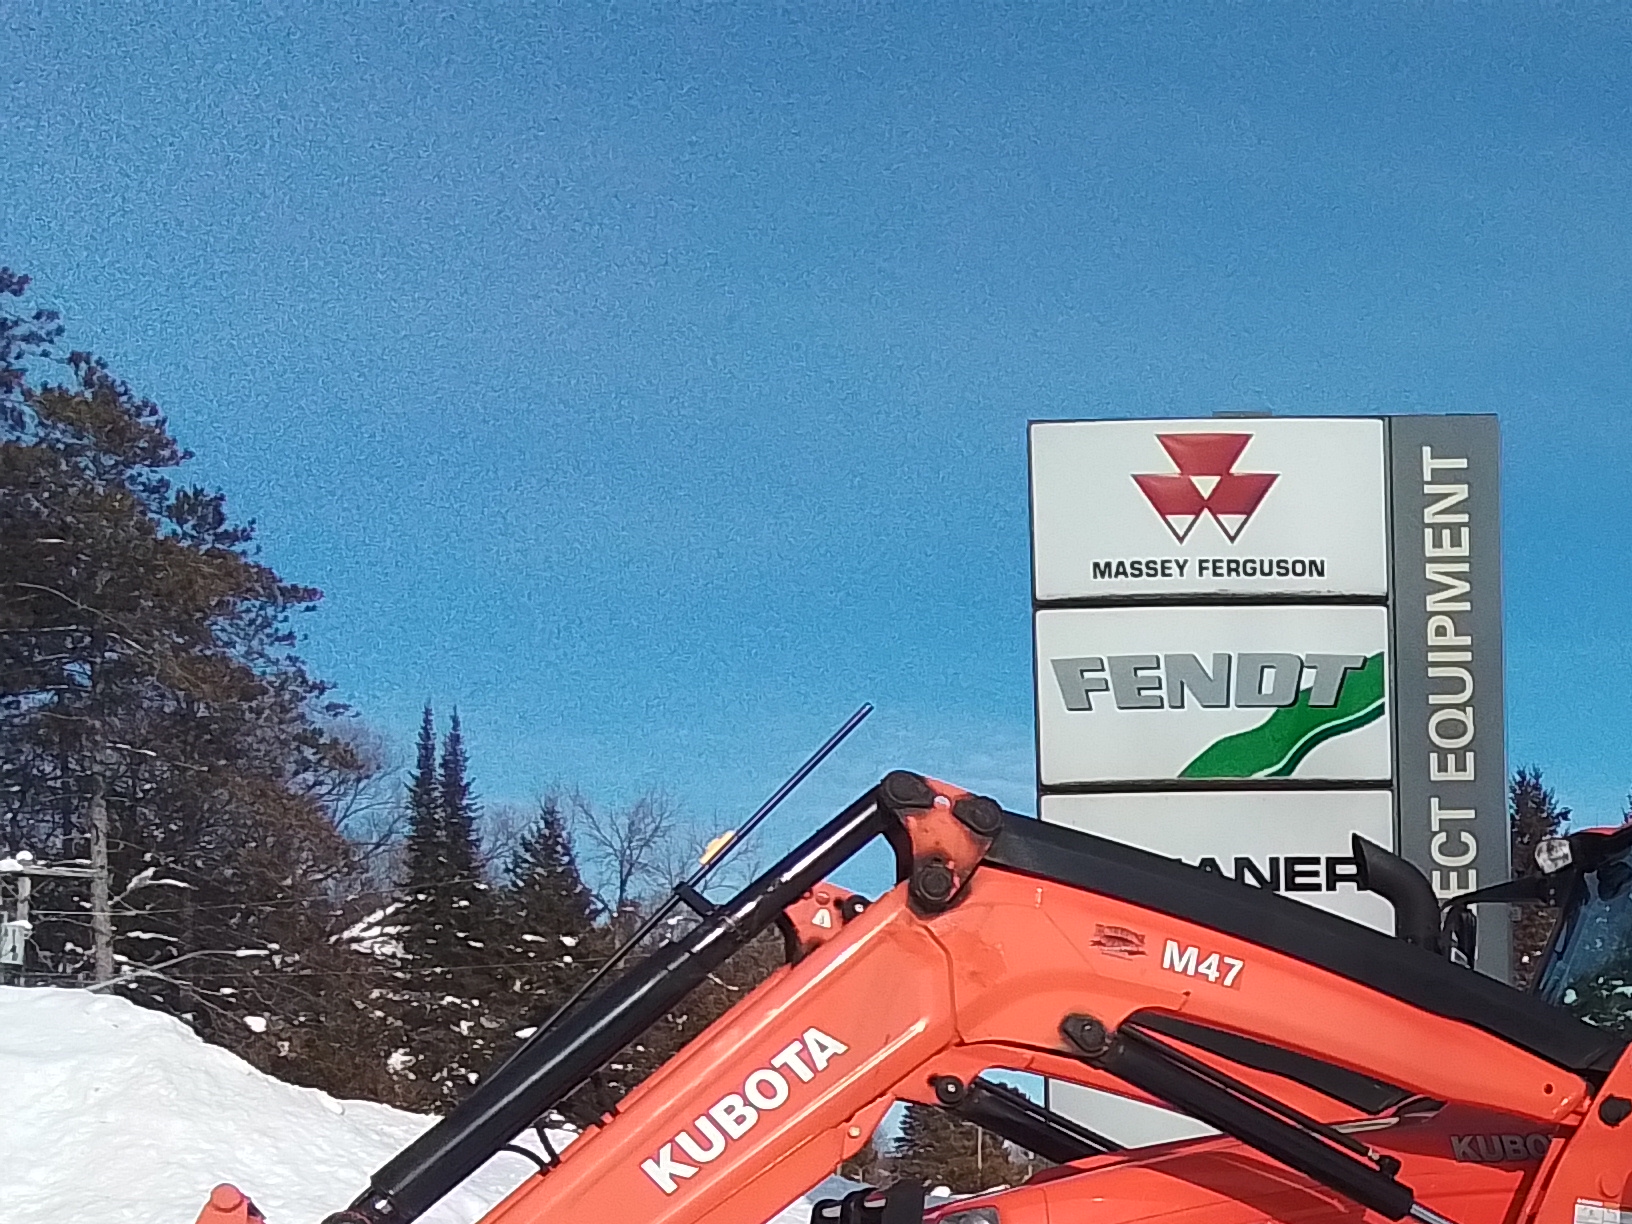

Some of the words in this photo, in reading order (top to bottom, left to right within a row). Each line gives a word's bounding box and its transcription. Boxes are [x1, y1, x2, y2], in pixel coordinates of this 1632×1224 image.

[1092, 558, 1189, 579] MASSEY
[1198, 558, 1325, 578] FERGUSON
[1422, 446, 1475, 782] EQUIPMENT
[1050, 652, 1367, 711] FENDT
[1431, 797, 1479, 910] ECT
[1162, 939, 1244, 987] M47
[640, 1027, 849, 1194] KUBOTA
[1450, 1133, 1554, 1161] KUBO
